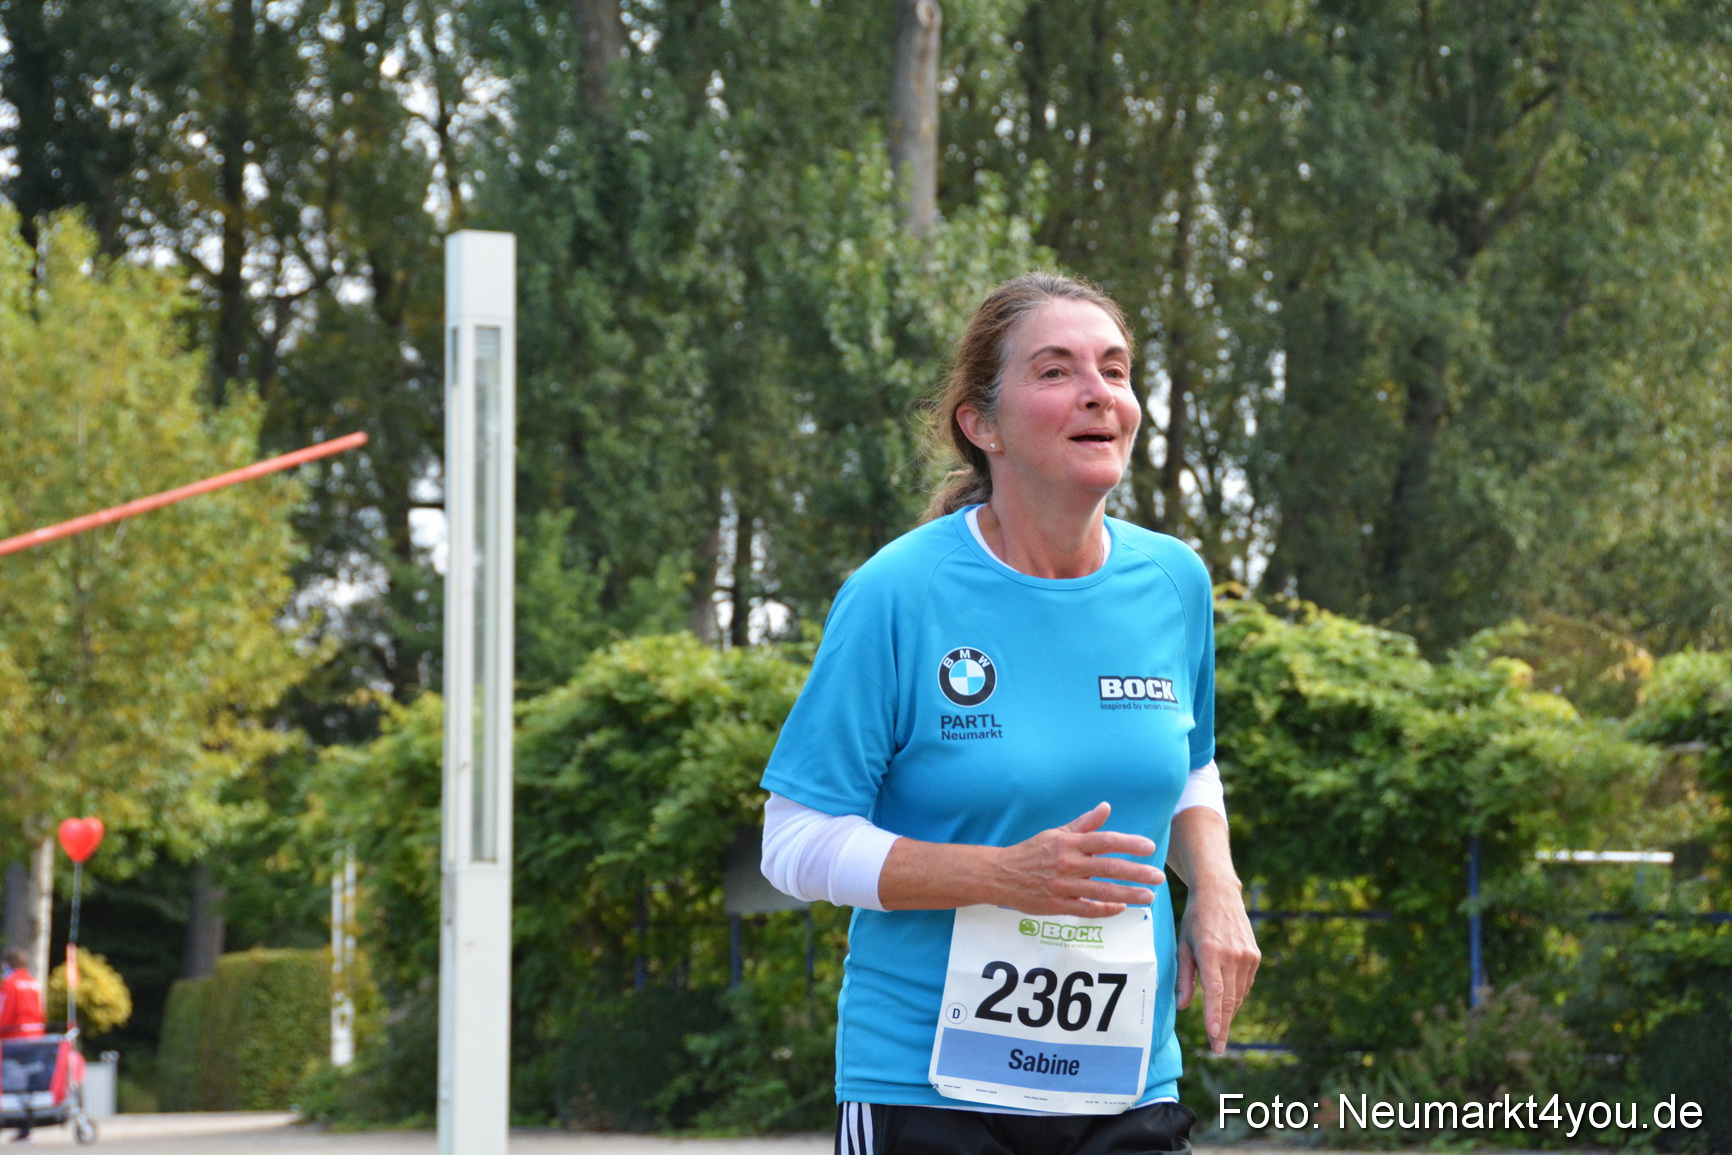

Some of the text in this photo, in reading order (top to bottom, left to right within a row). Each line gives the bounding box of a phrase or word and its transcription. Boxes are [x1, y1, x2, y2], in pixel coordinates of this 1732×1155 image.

[942, 649, 990, 669] BMW
[1098, 676, 1178, 703] BOCK
[1100, 702, 1132, 711] inspired
[1133, 702, 1143, 711] by
[940, 714, 1002, 729] PARTL
[941, 729, 1003, 741] Neumarkt
[1042, 922, 1103, 942] BOCK
[975, 960, 1128, 1032] 2367
[952, 1008, 961, 1019] D
[1008, 1048, 1080, 1076] Sabine
